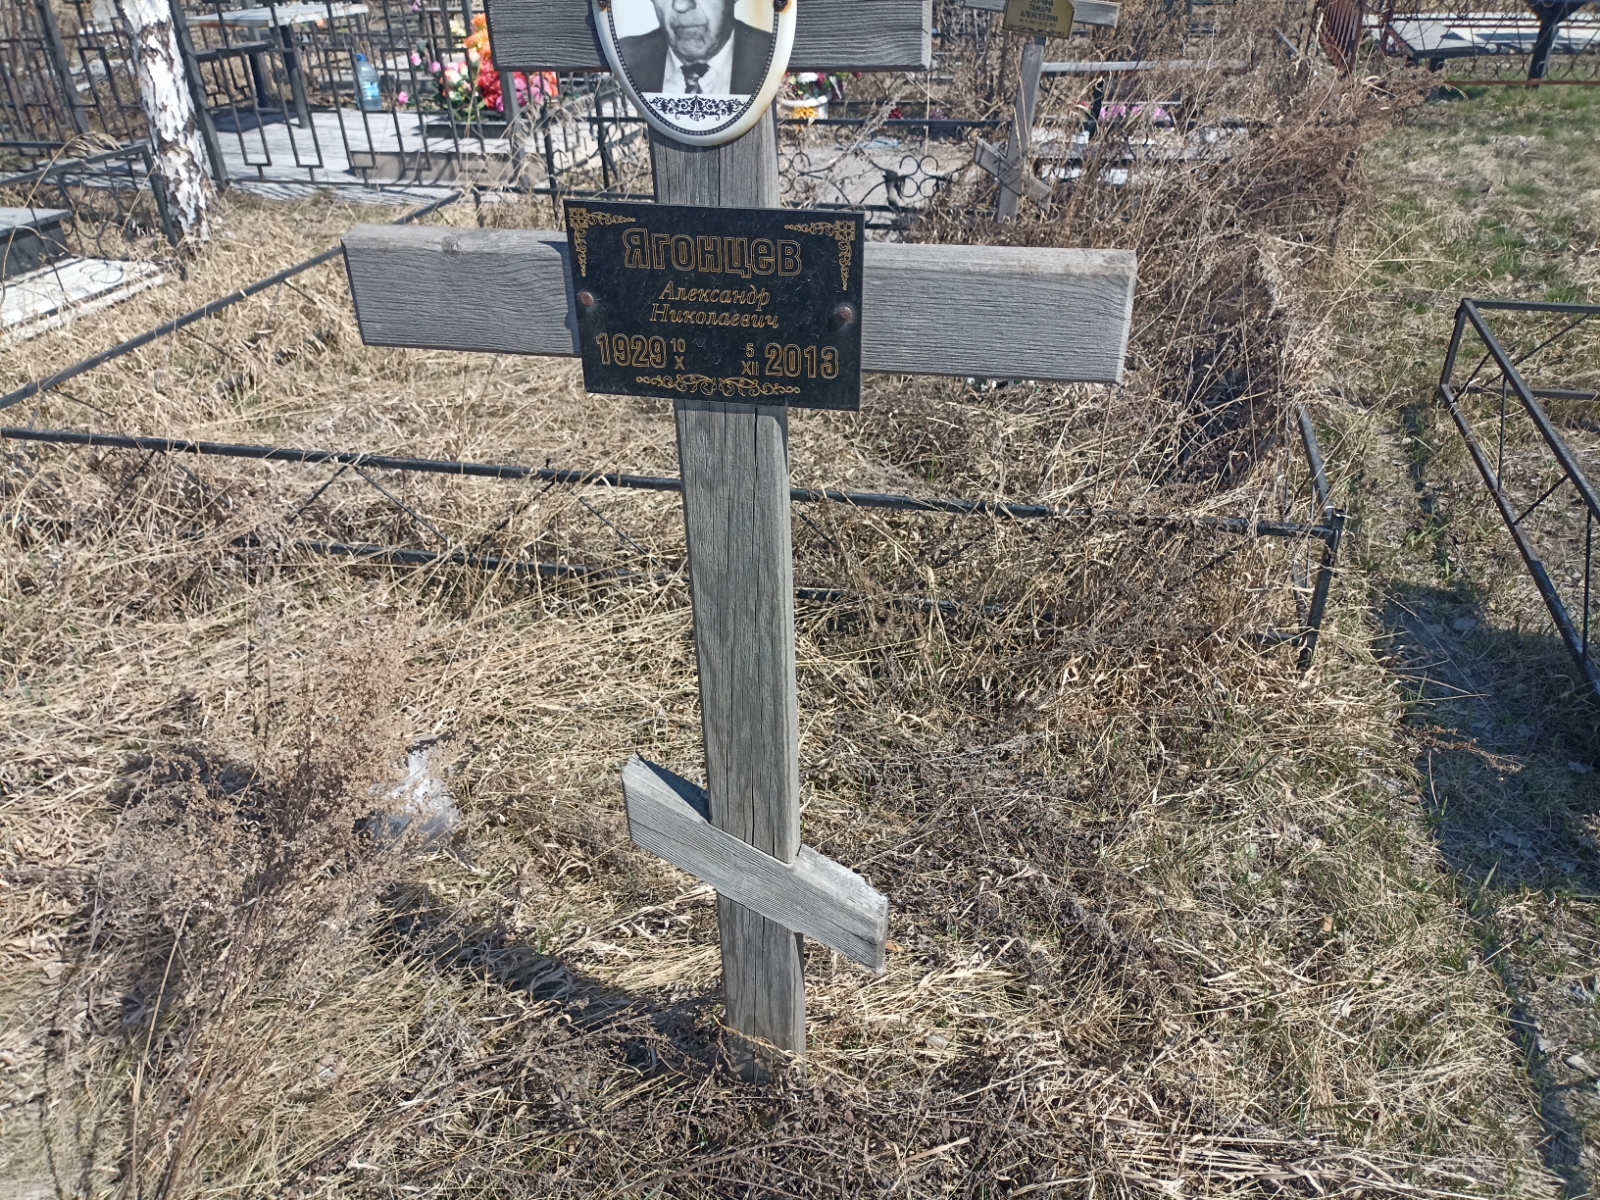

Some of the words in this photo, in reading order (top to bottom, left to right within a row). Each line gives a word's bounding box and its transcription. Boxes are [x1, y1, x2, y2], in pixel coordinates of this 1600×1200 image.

[659, 281, 770, 312] Александр
[650, 303, 779, 329] Николаевич
[596, 333, 667, 369] 1929
[671, 338, 686, 353] 10
[745, 343, 755, 358] 5
[764, 343, 839, 379] 2013
